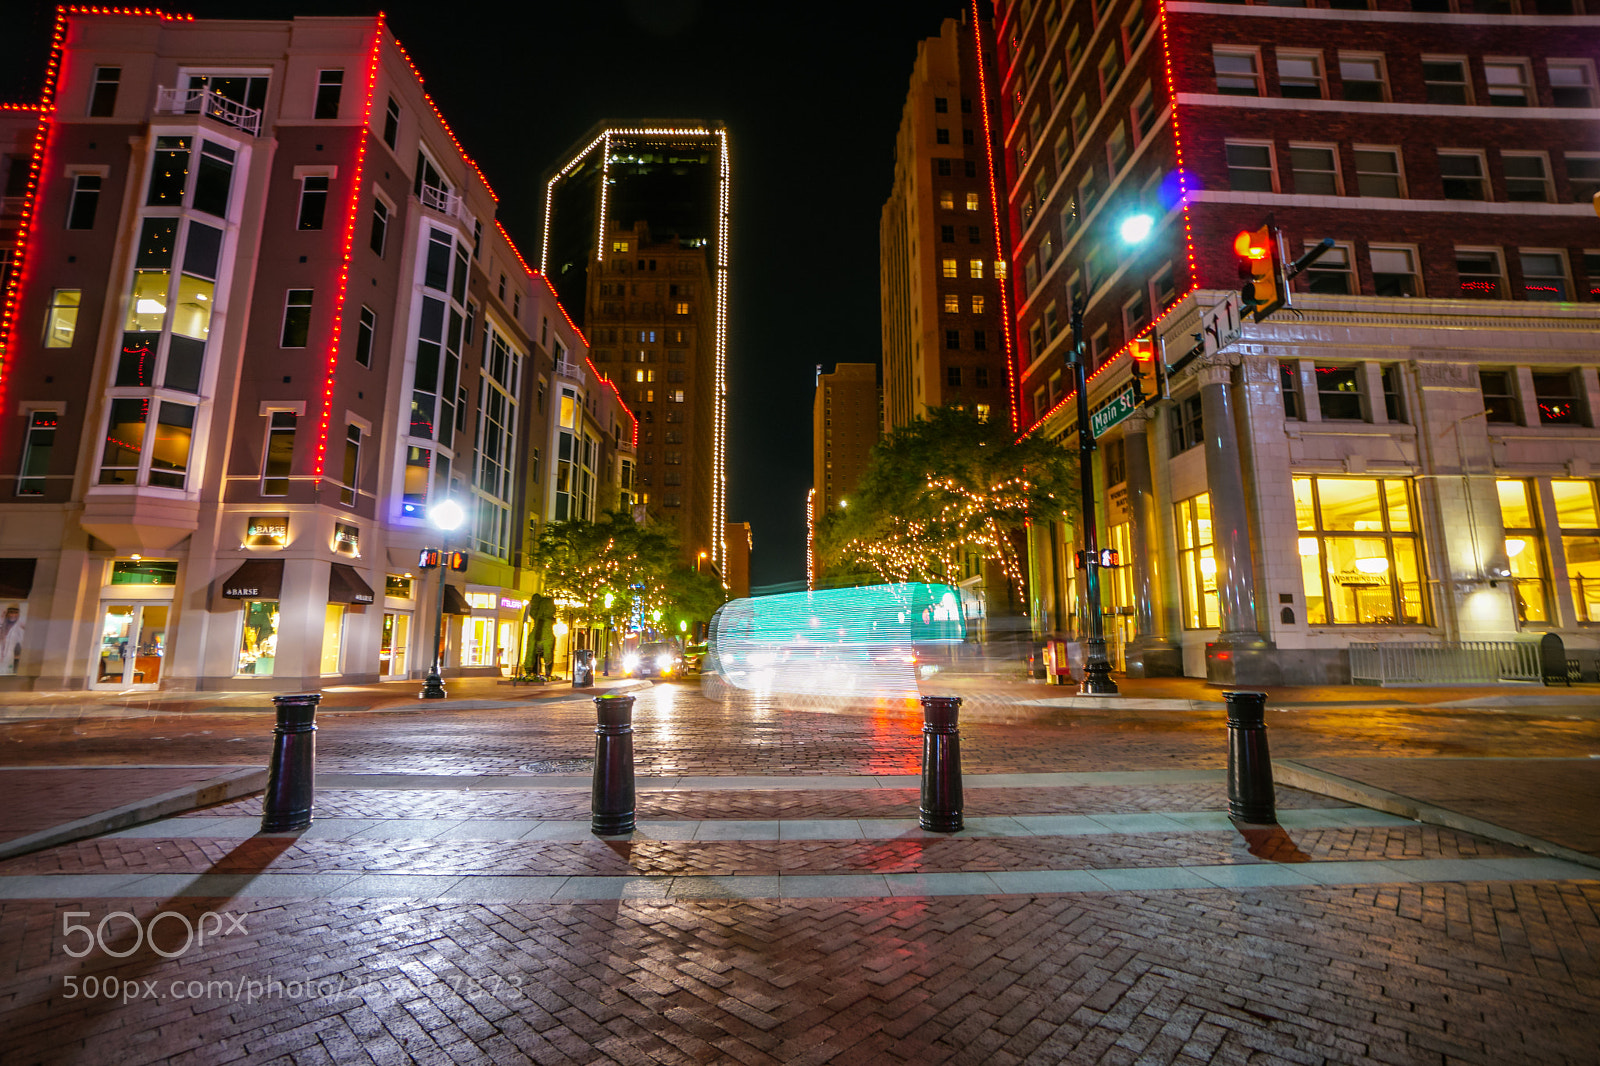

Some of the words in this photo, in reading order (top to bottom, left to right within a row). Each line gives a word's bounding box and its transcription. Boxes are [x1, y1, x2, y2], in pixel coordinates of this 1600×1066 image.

[1095, 406, 1117, 430] Main
[1120, 394, 1133, 412] St
[256, 525, 286, 534] BARSE
[232, 588, 258, 596] BARSE
